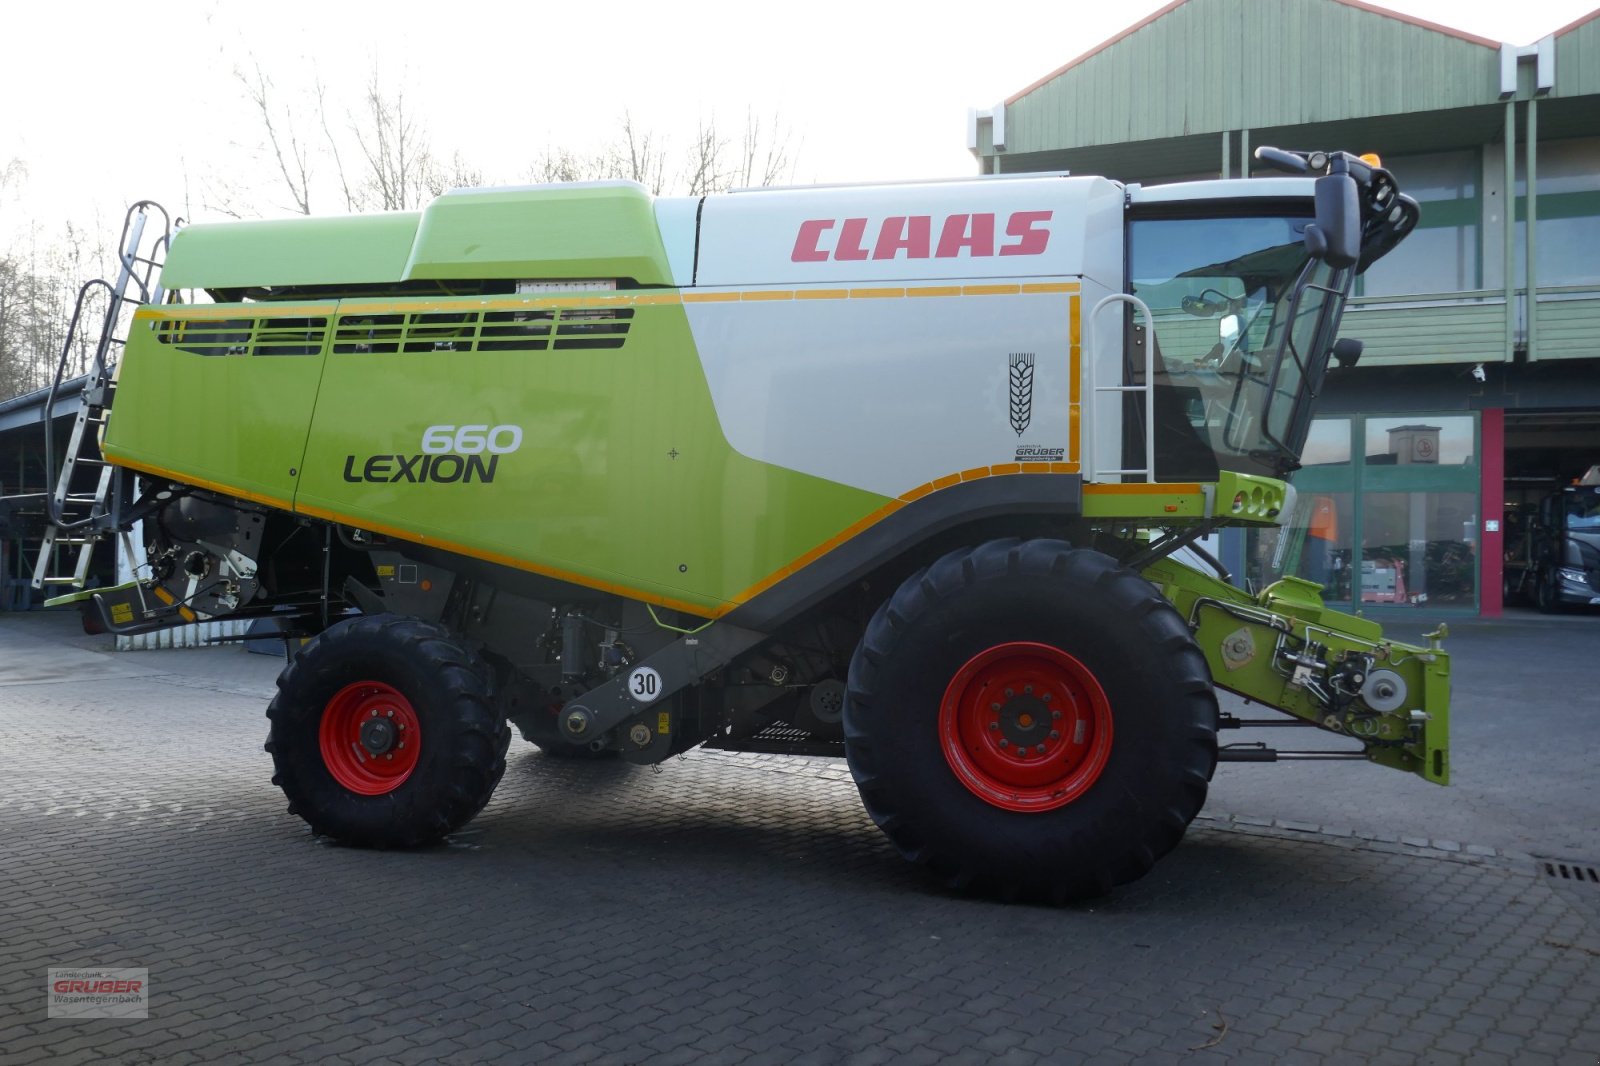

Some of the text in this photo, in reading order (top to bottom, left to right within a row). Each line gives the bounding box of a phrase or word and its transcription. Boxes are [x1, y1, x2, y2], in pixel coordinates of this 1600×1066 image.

[790, 210, 1054, 263] CLAAS
[421, 424, 523, 454] 660
[1015, 448, 1065, 456] GRUBER
[343, 454, 500, 484] LEXION
[633, 673, 656, 695] 30
